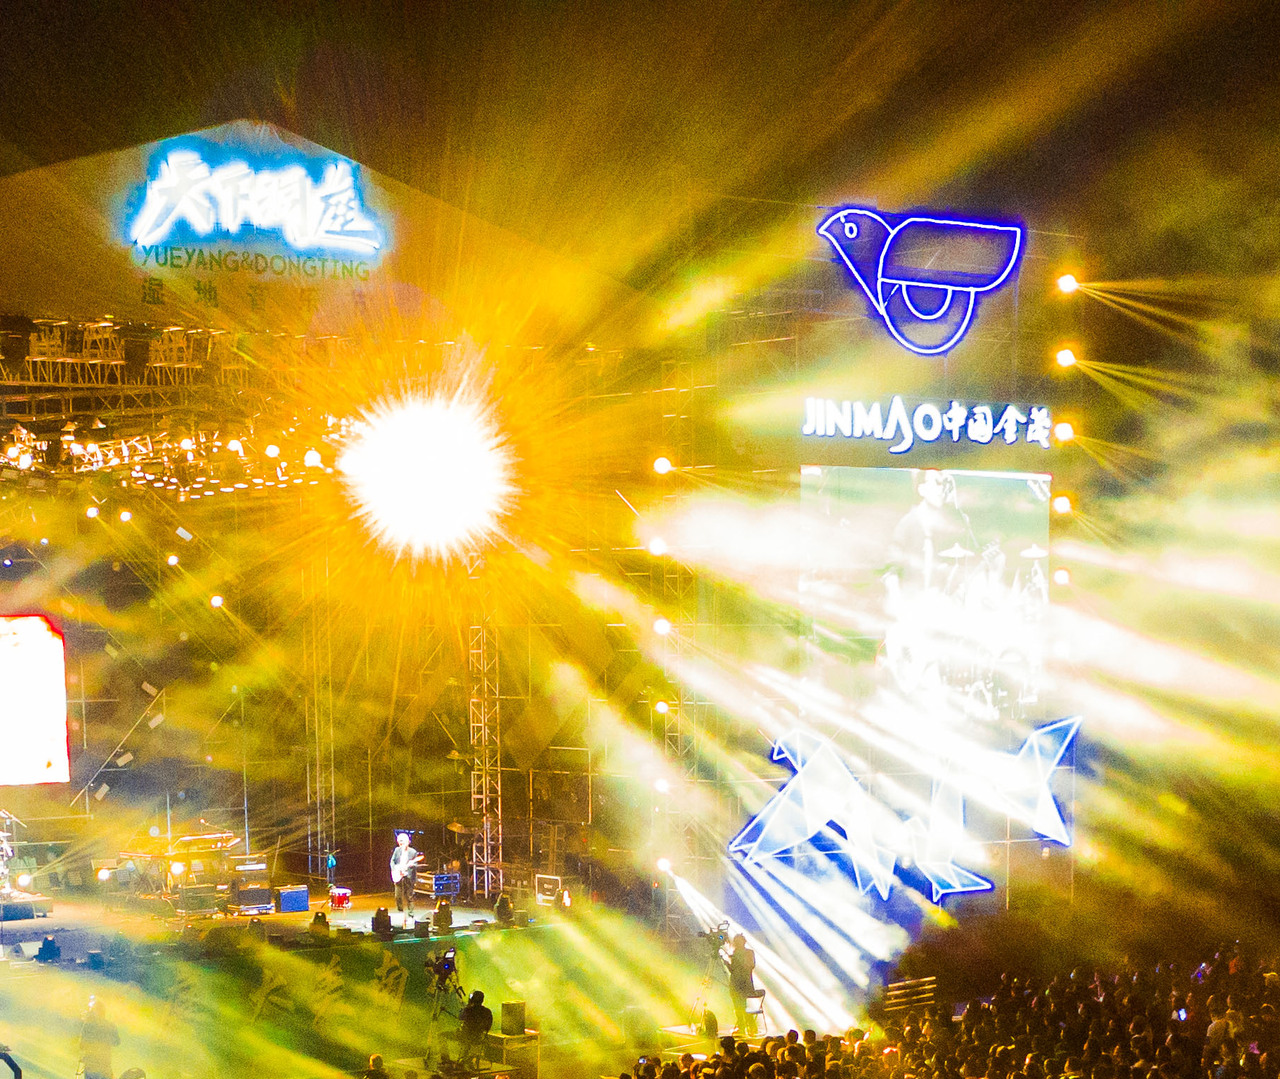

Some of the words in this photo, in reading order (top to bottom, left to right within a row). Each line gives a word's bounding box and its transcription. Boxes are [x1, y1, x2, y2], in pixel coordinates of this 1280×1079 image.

[141, 245, 370, 281] YUEYANG&DONGTING
[802, 395, 942, 454] JINMAO
[943, 400, 1052, 449] 中国金茂
